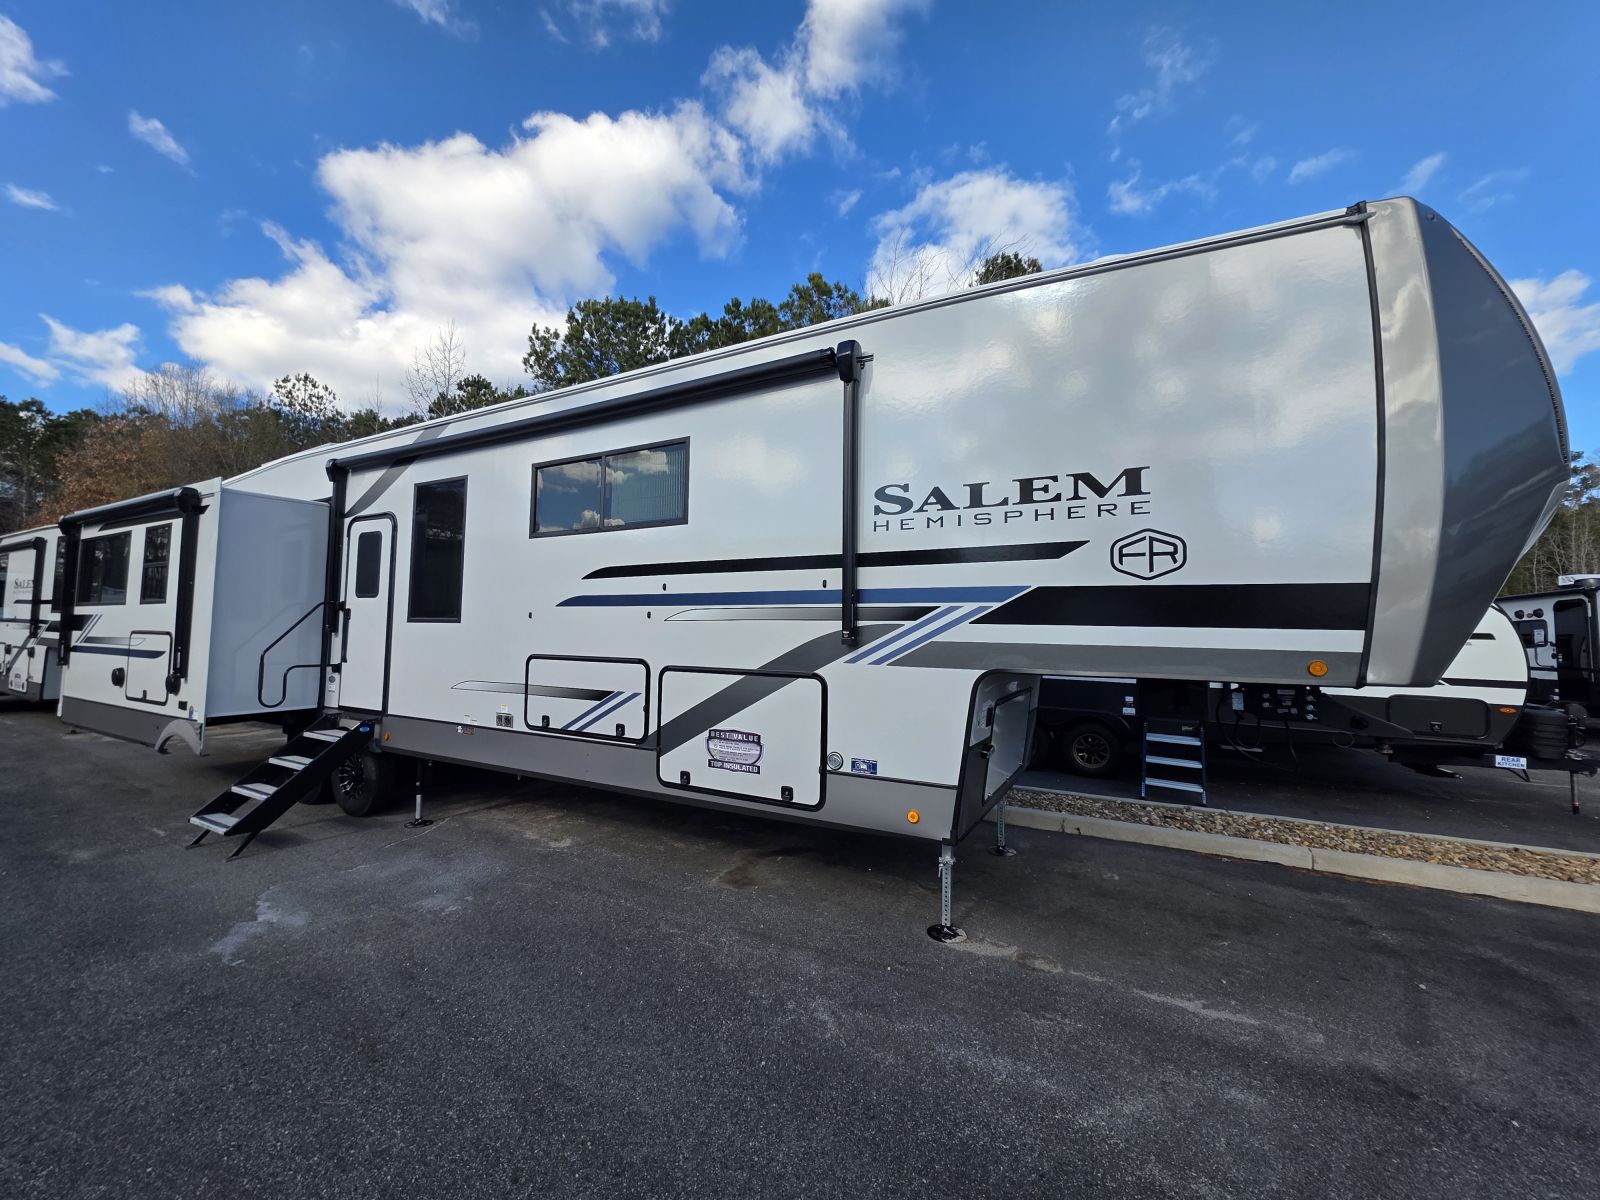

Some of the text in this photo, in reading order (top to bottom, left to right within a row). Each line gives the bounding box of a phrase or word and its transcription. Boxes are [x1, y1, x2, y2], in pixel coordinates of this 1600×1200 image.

[873, 466, 1151, 516] SALEM
[873, 500, 1151, 532] HEMISPHERE
[1118, 535, 1179, 574] FR
[14, 578, 34, 589] SALE
[723, 762, 758, 773] INSULATED
